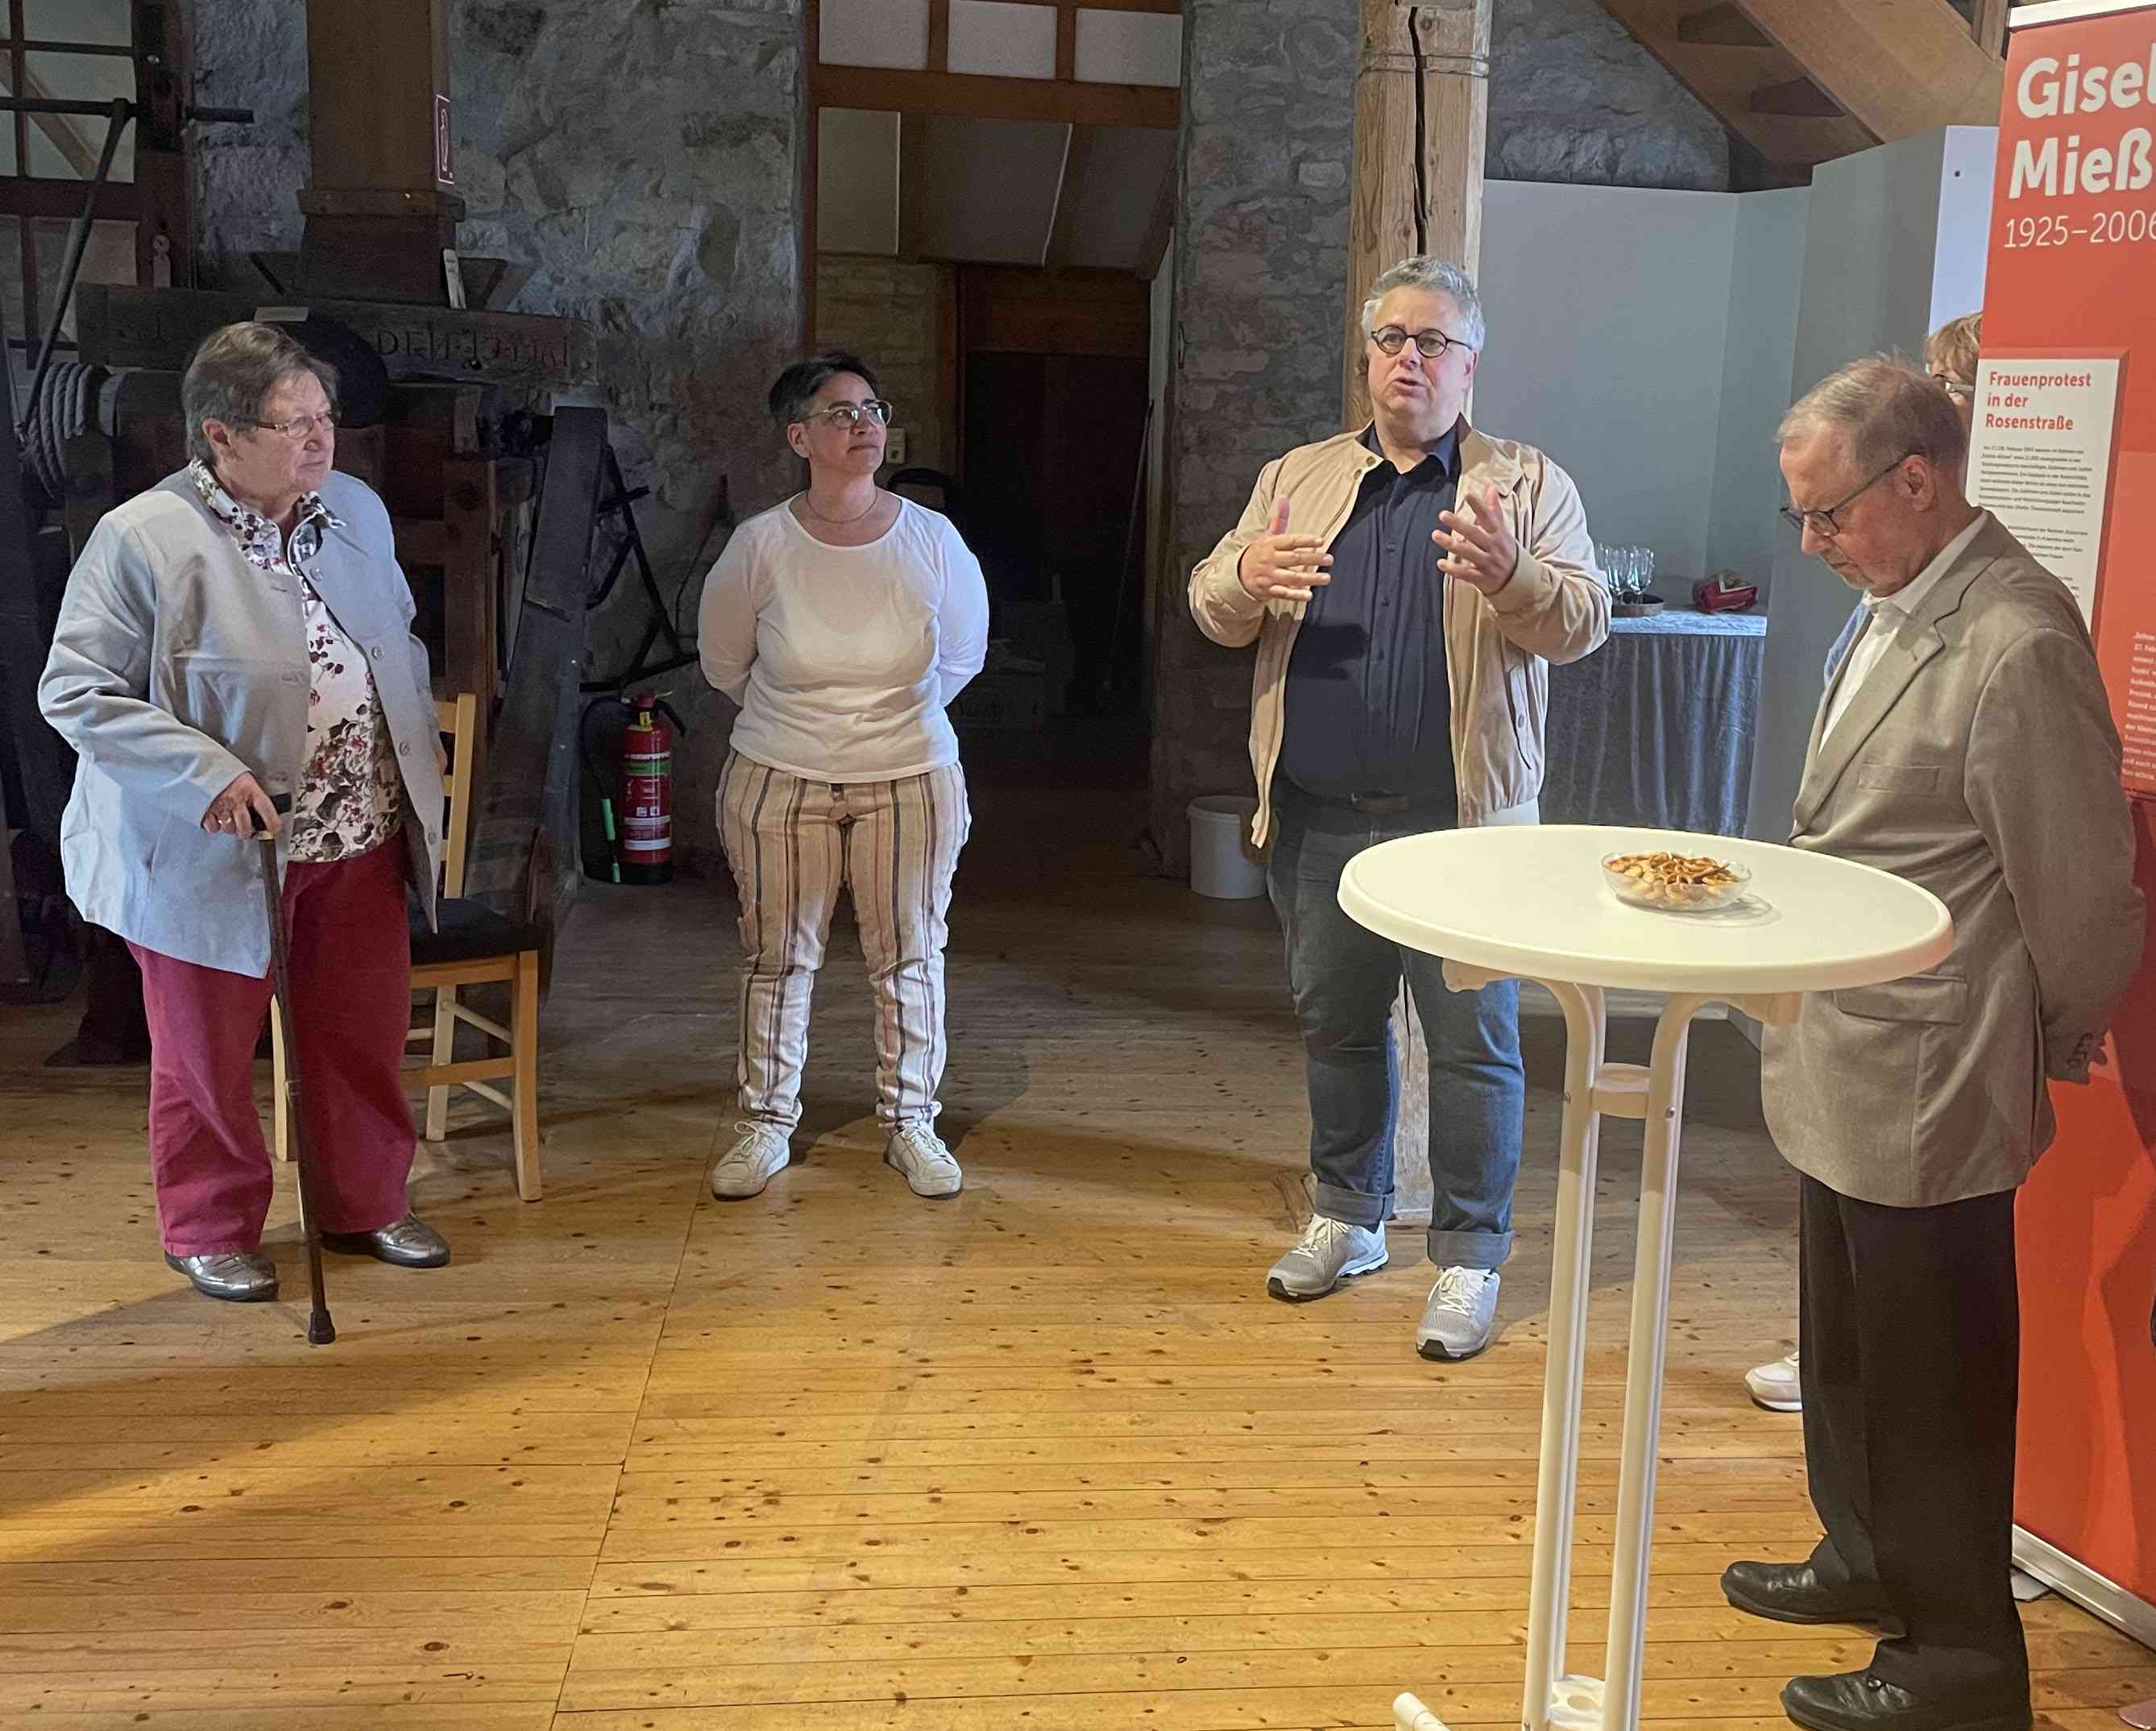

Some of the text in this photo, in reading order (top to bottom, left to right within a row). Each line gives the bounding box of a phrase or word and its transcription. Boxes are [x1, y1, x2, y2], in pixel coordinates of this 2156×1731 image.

[2009, 127, 2153, 199] Mieß
[1989, 371, 2092, 390] Frauenprotest
[1987, 393, 2029, 408] in der
[1985, 413, 2074, 430] Rosenstraße
